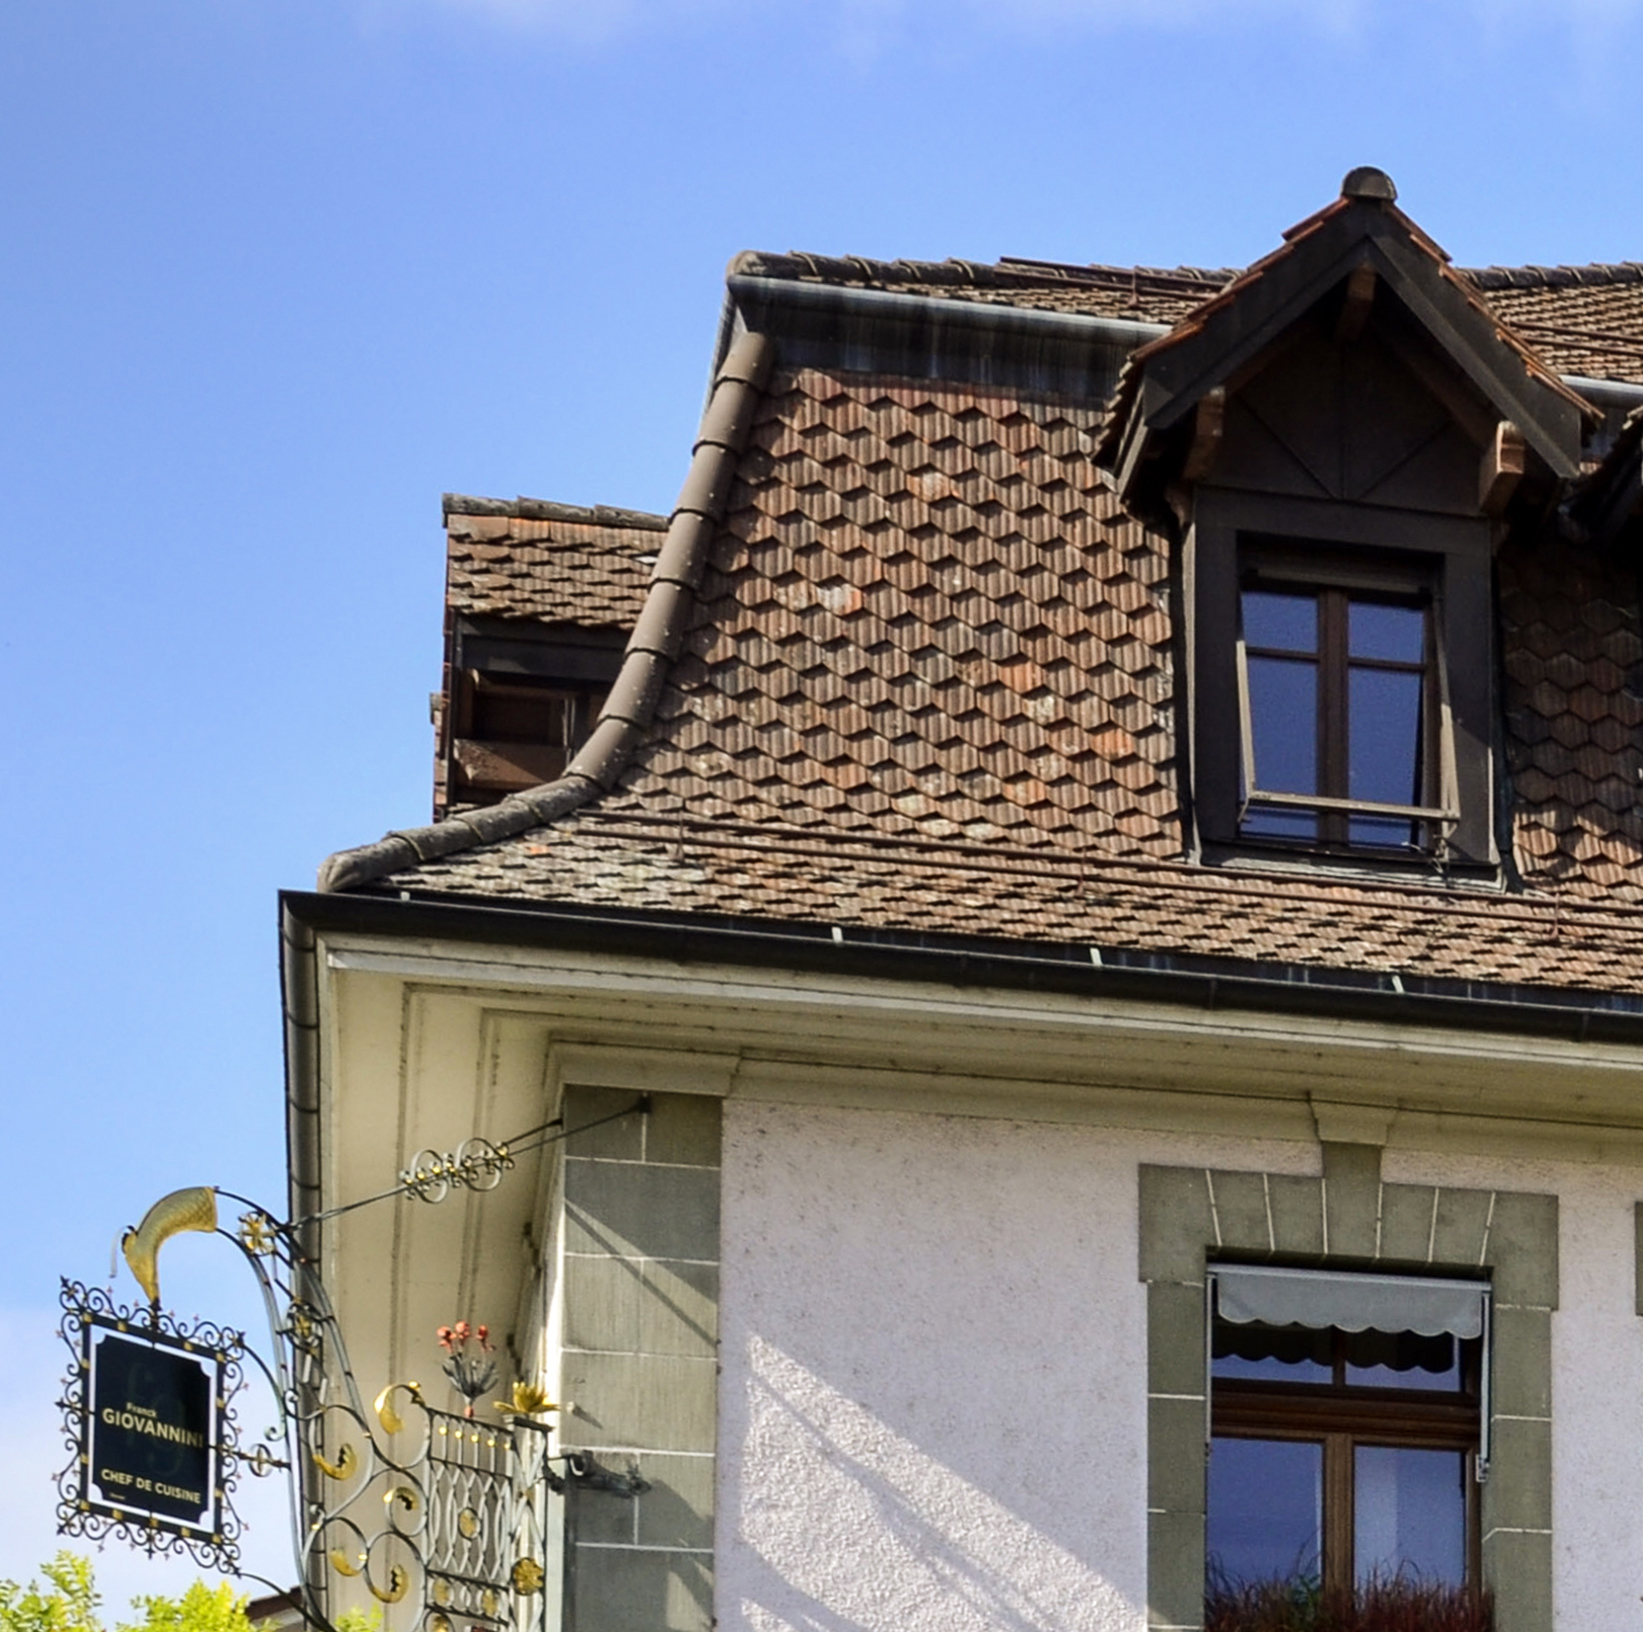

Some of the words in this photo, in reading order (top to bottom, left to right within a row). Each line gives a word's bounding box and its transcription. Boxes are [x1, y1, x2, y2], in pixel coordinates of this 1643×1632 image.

[126, 1402, 158, 1418] Franck
[102, 1408, 204, 1448] GIOVANNINI
[101, 1469, 134, 1485] CHEF
[136, 1477, 153, 1492] DE
[155, 1483, 202, 1504] CUISINE
